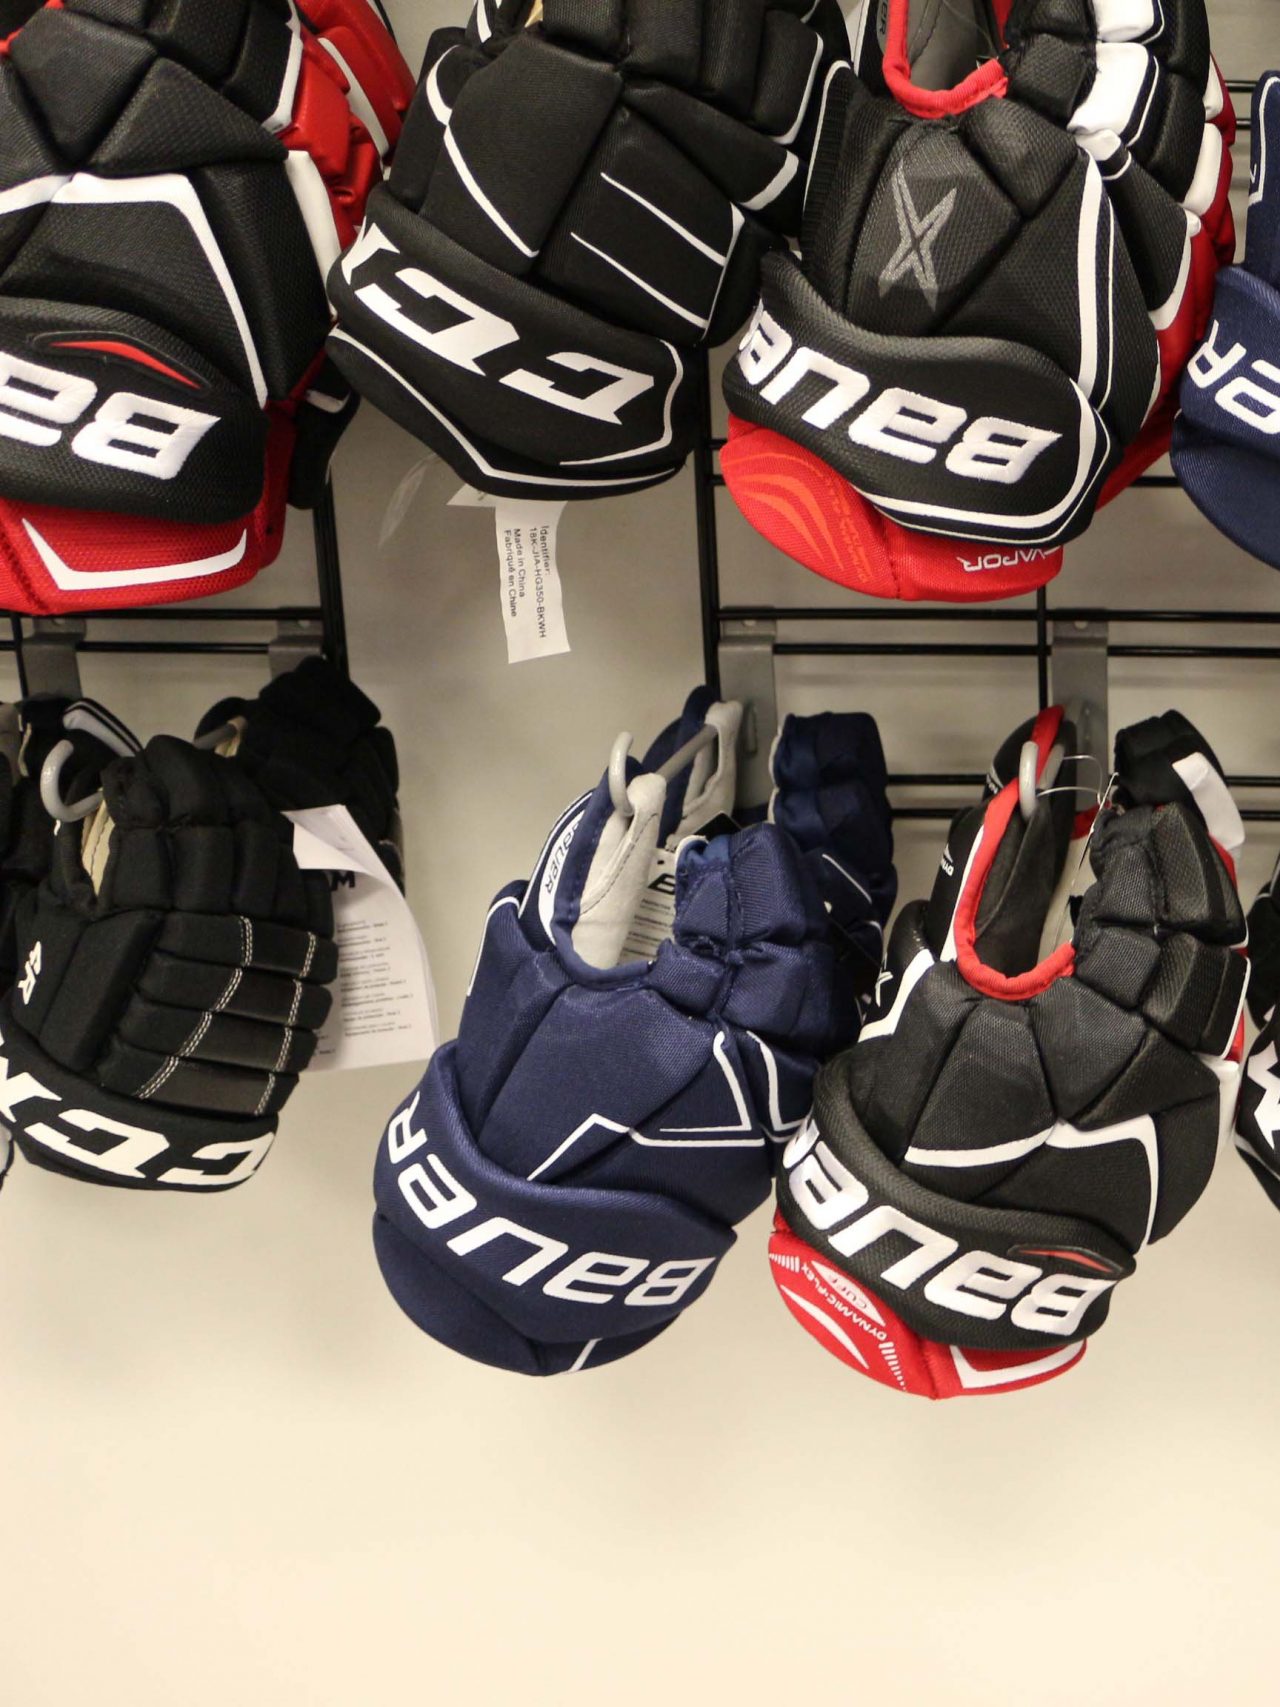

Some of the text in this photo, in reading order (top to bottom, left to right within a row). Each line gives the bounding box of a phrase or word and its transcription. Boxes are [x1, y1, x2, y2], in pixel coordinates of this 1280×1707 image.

[508, 574, 515, 587] en
[513, 528, 527, 598] Made in China
[957, 546, 1061, 573] VAPOR
[509, 589, 518, 617] Chine
[545, 820, 583, 894] AUER
[386, 1091, 716, 1306] BAUER
